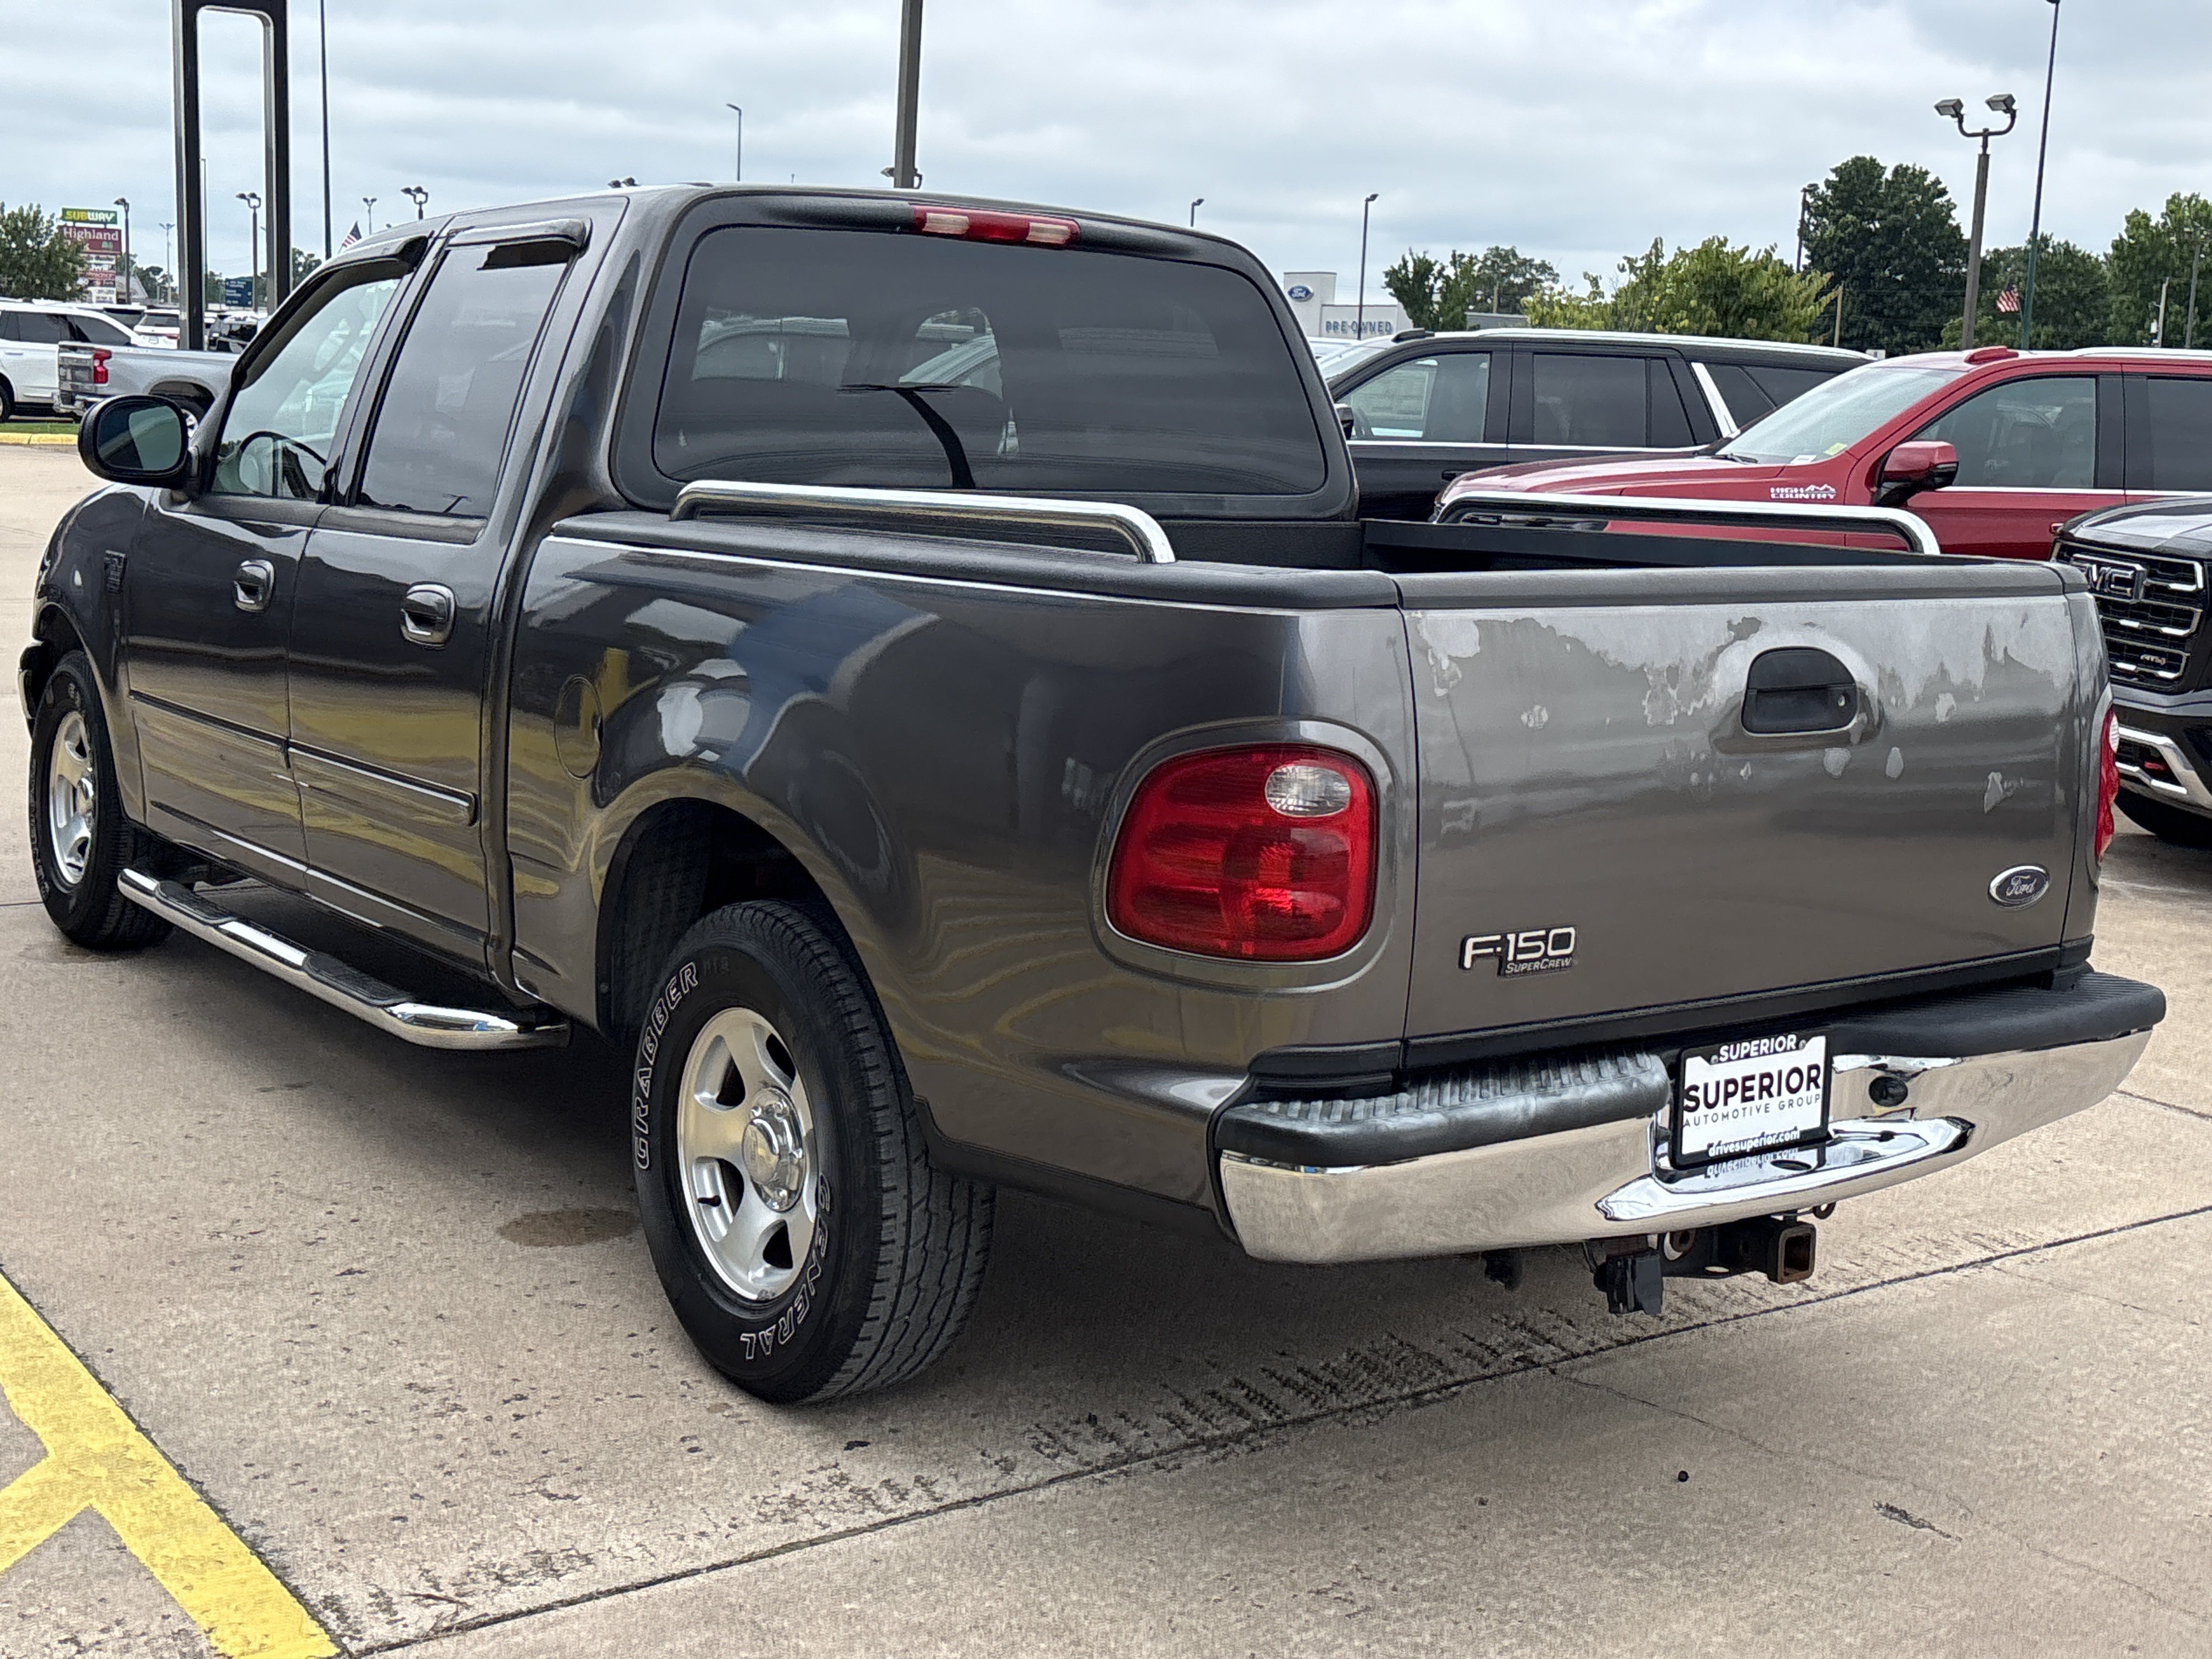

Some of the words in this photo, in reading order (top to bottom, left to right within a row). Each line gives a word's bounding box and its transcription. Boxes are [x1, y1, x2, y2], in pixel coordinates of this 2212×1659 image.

[65, 211, 115, 222] SUBWAY
[63, 227, 119, 241] Highland
[1325, 320, 1392, 333] PRE-OWNED
[2085, 563, 2135, 597] MC
[2006, 874, 2037, 896] Ford
[1719, 1034, 1797, 1062] SUPERIOR
[635, 962, 698, 1170] GRABBER
[1683, 1063, 1821, 1113] SUPERIOR
[1683, 1103, 1770, 1127] AUTOMOTIVE
[1778, 1093, 1820, 1111] GROUP
[1708, 1127, 1800, 1156] drivesuperior.com
[740, 1175, 830, 1360] GENERAL
